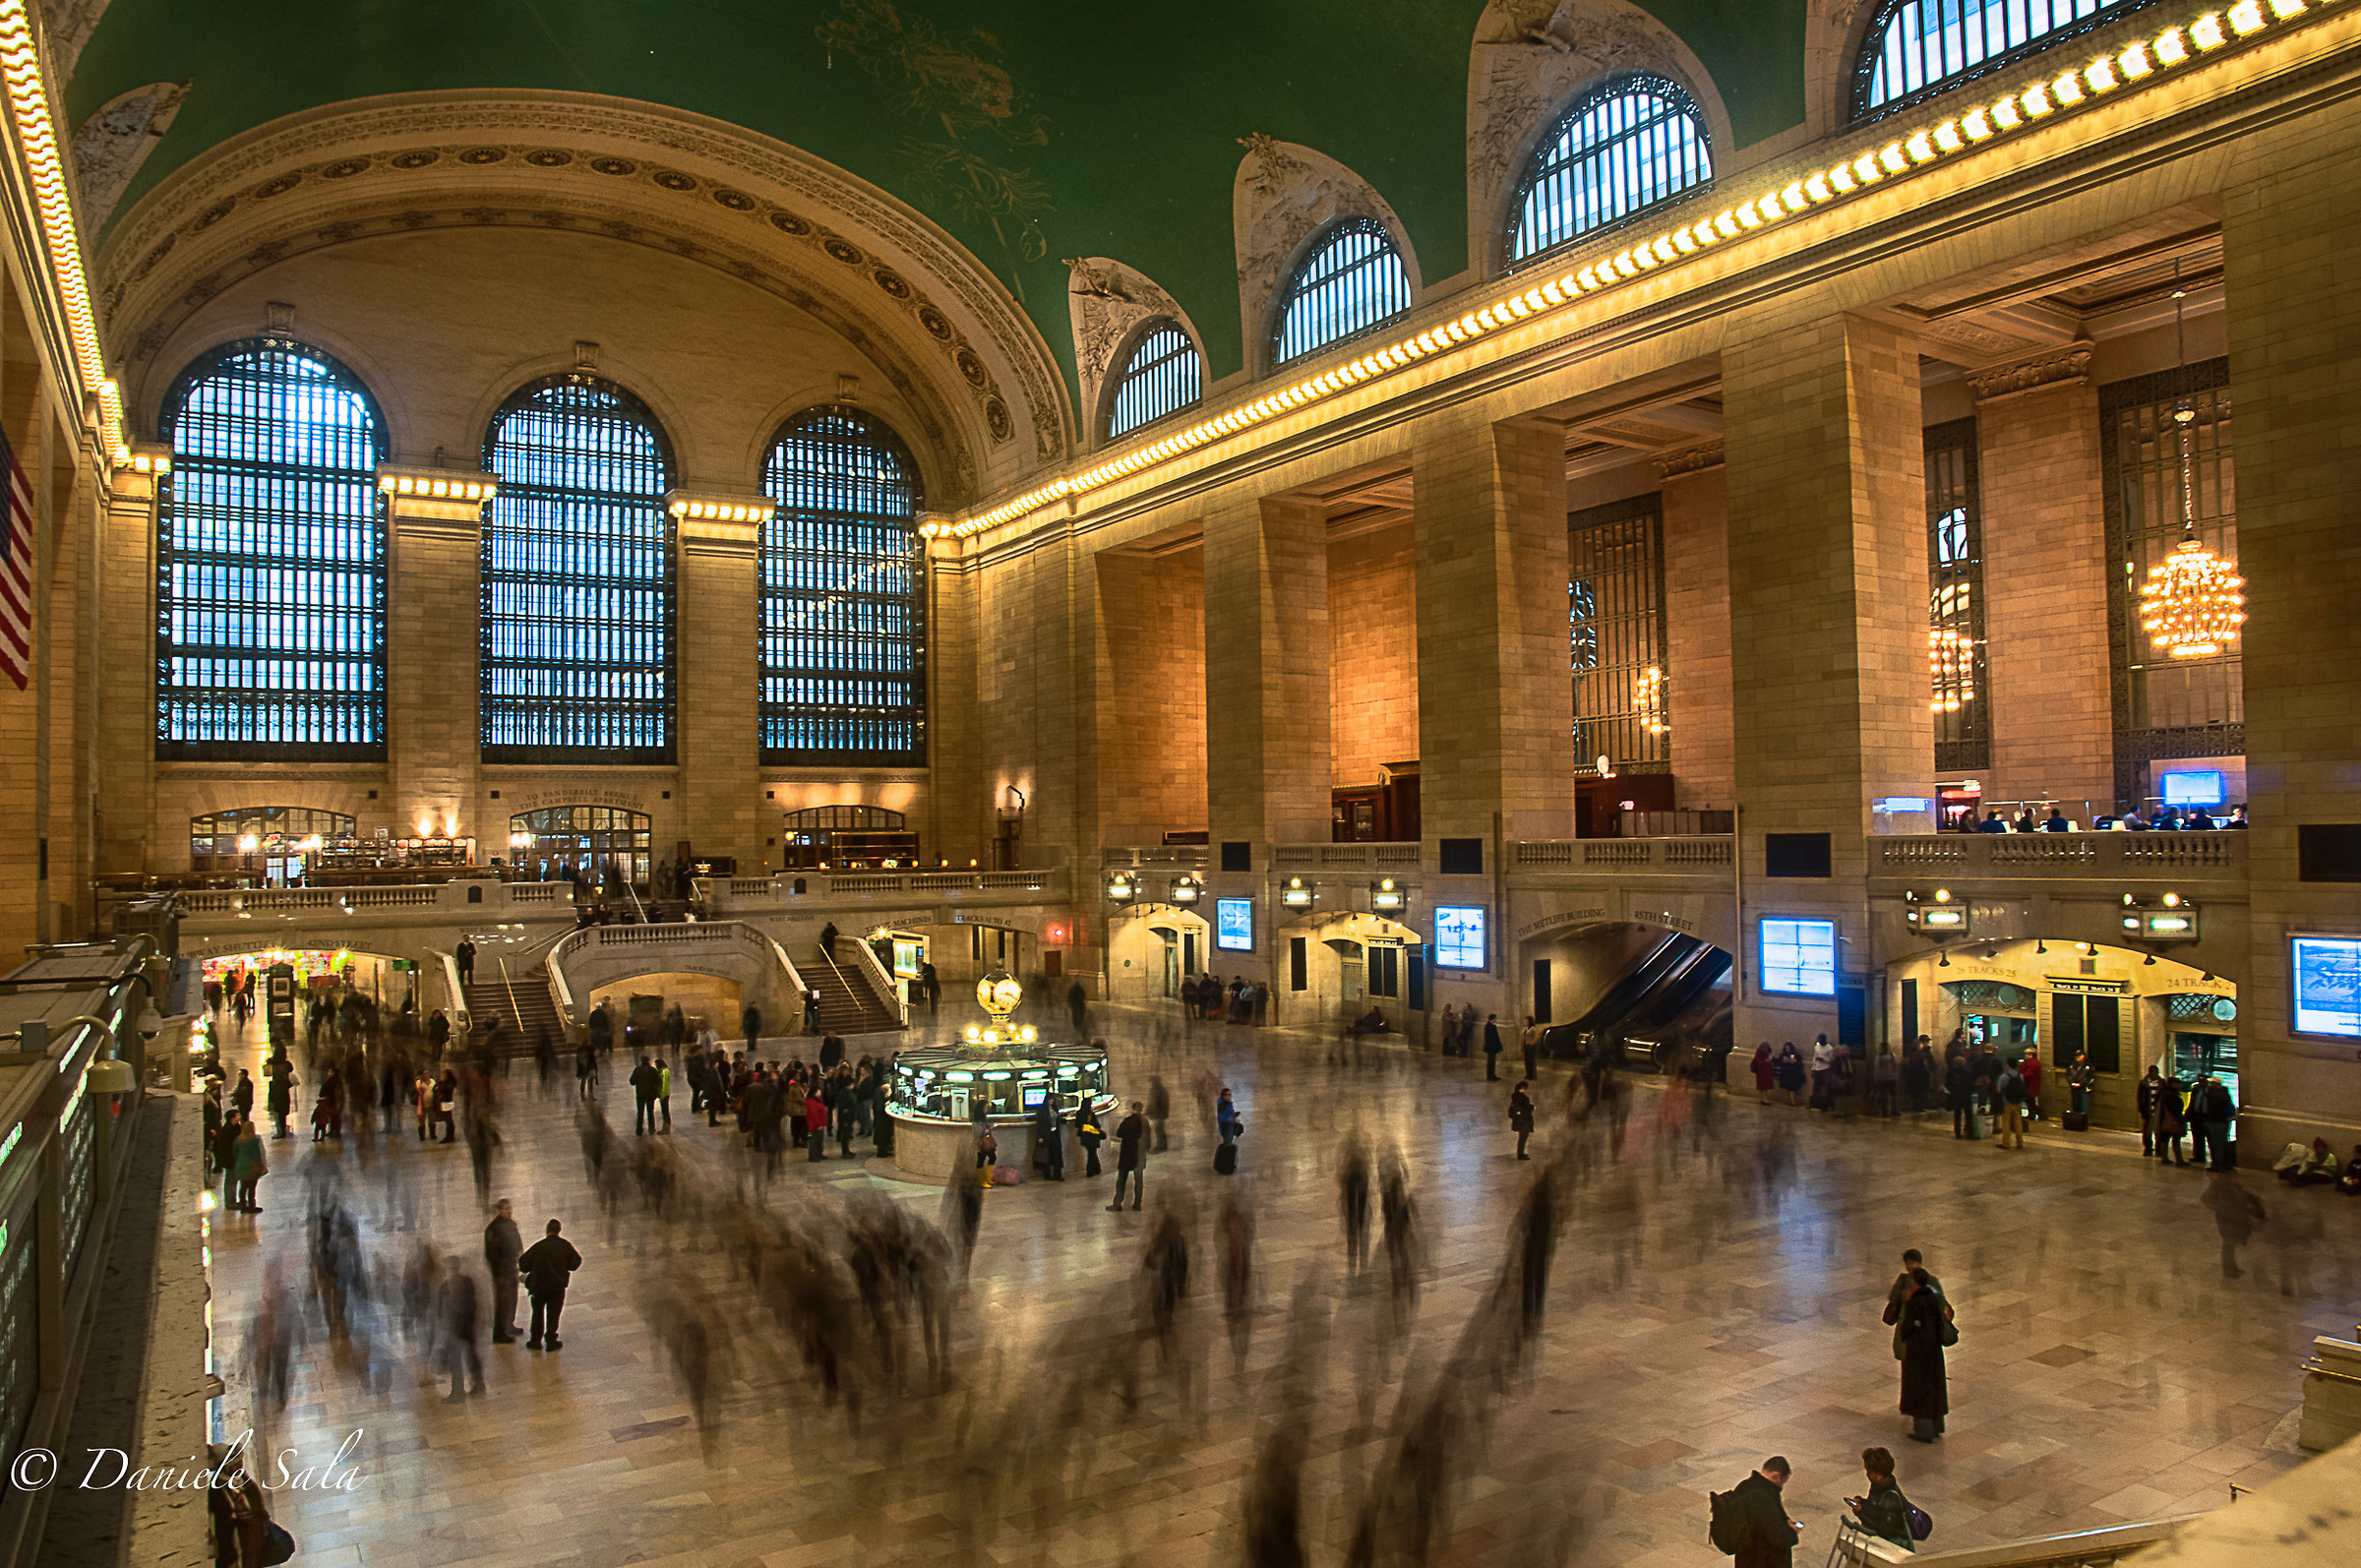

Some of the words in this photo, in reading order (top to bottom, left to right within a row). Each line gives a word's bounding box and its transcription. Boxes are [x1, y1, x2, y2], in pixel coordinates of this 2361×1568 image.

[542, 789, 598, 798] VANDERBILT
[519, 801, 539, 810] THE
[1517, 925, 1533, 937] THE
[1533, 913, 1566, 930] METLIFE
[1566, 908, 1605, 921] BUILDING
[1634, 910, 1657, 923] 45TH
[1658, 914, 1694, 932] STREET
[1968, 965, 2005, 976] TRACKS
[2006, 969, 2017, 978] 25
[2166, 977, 2181, 988] 24
